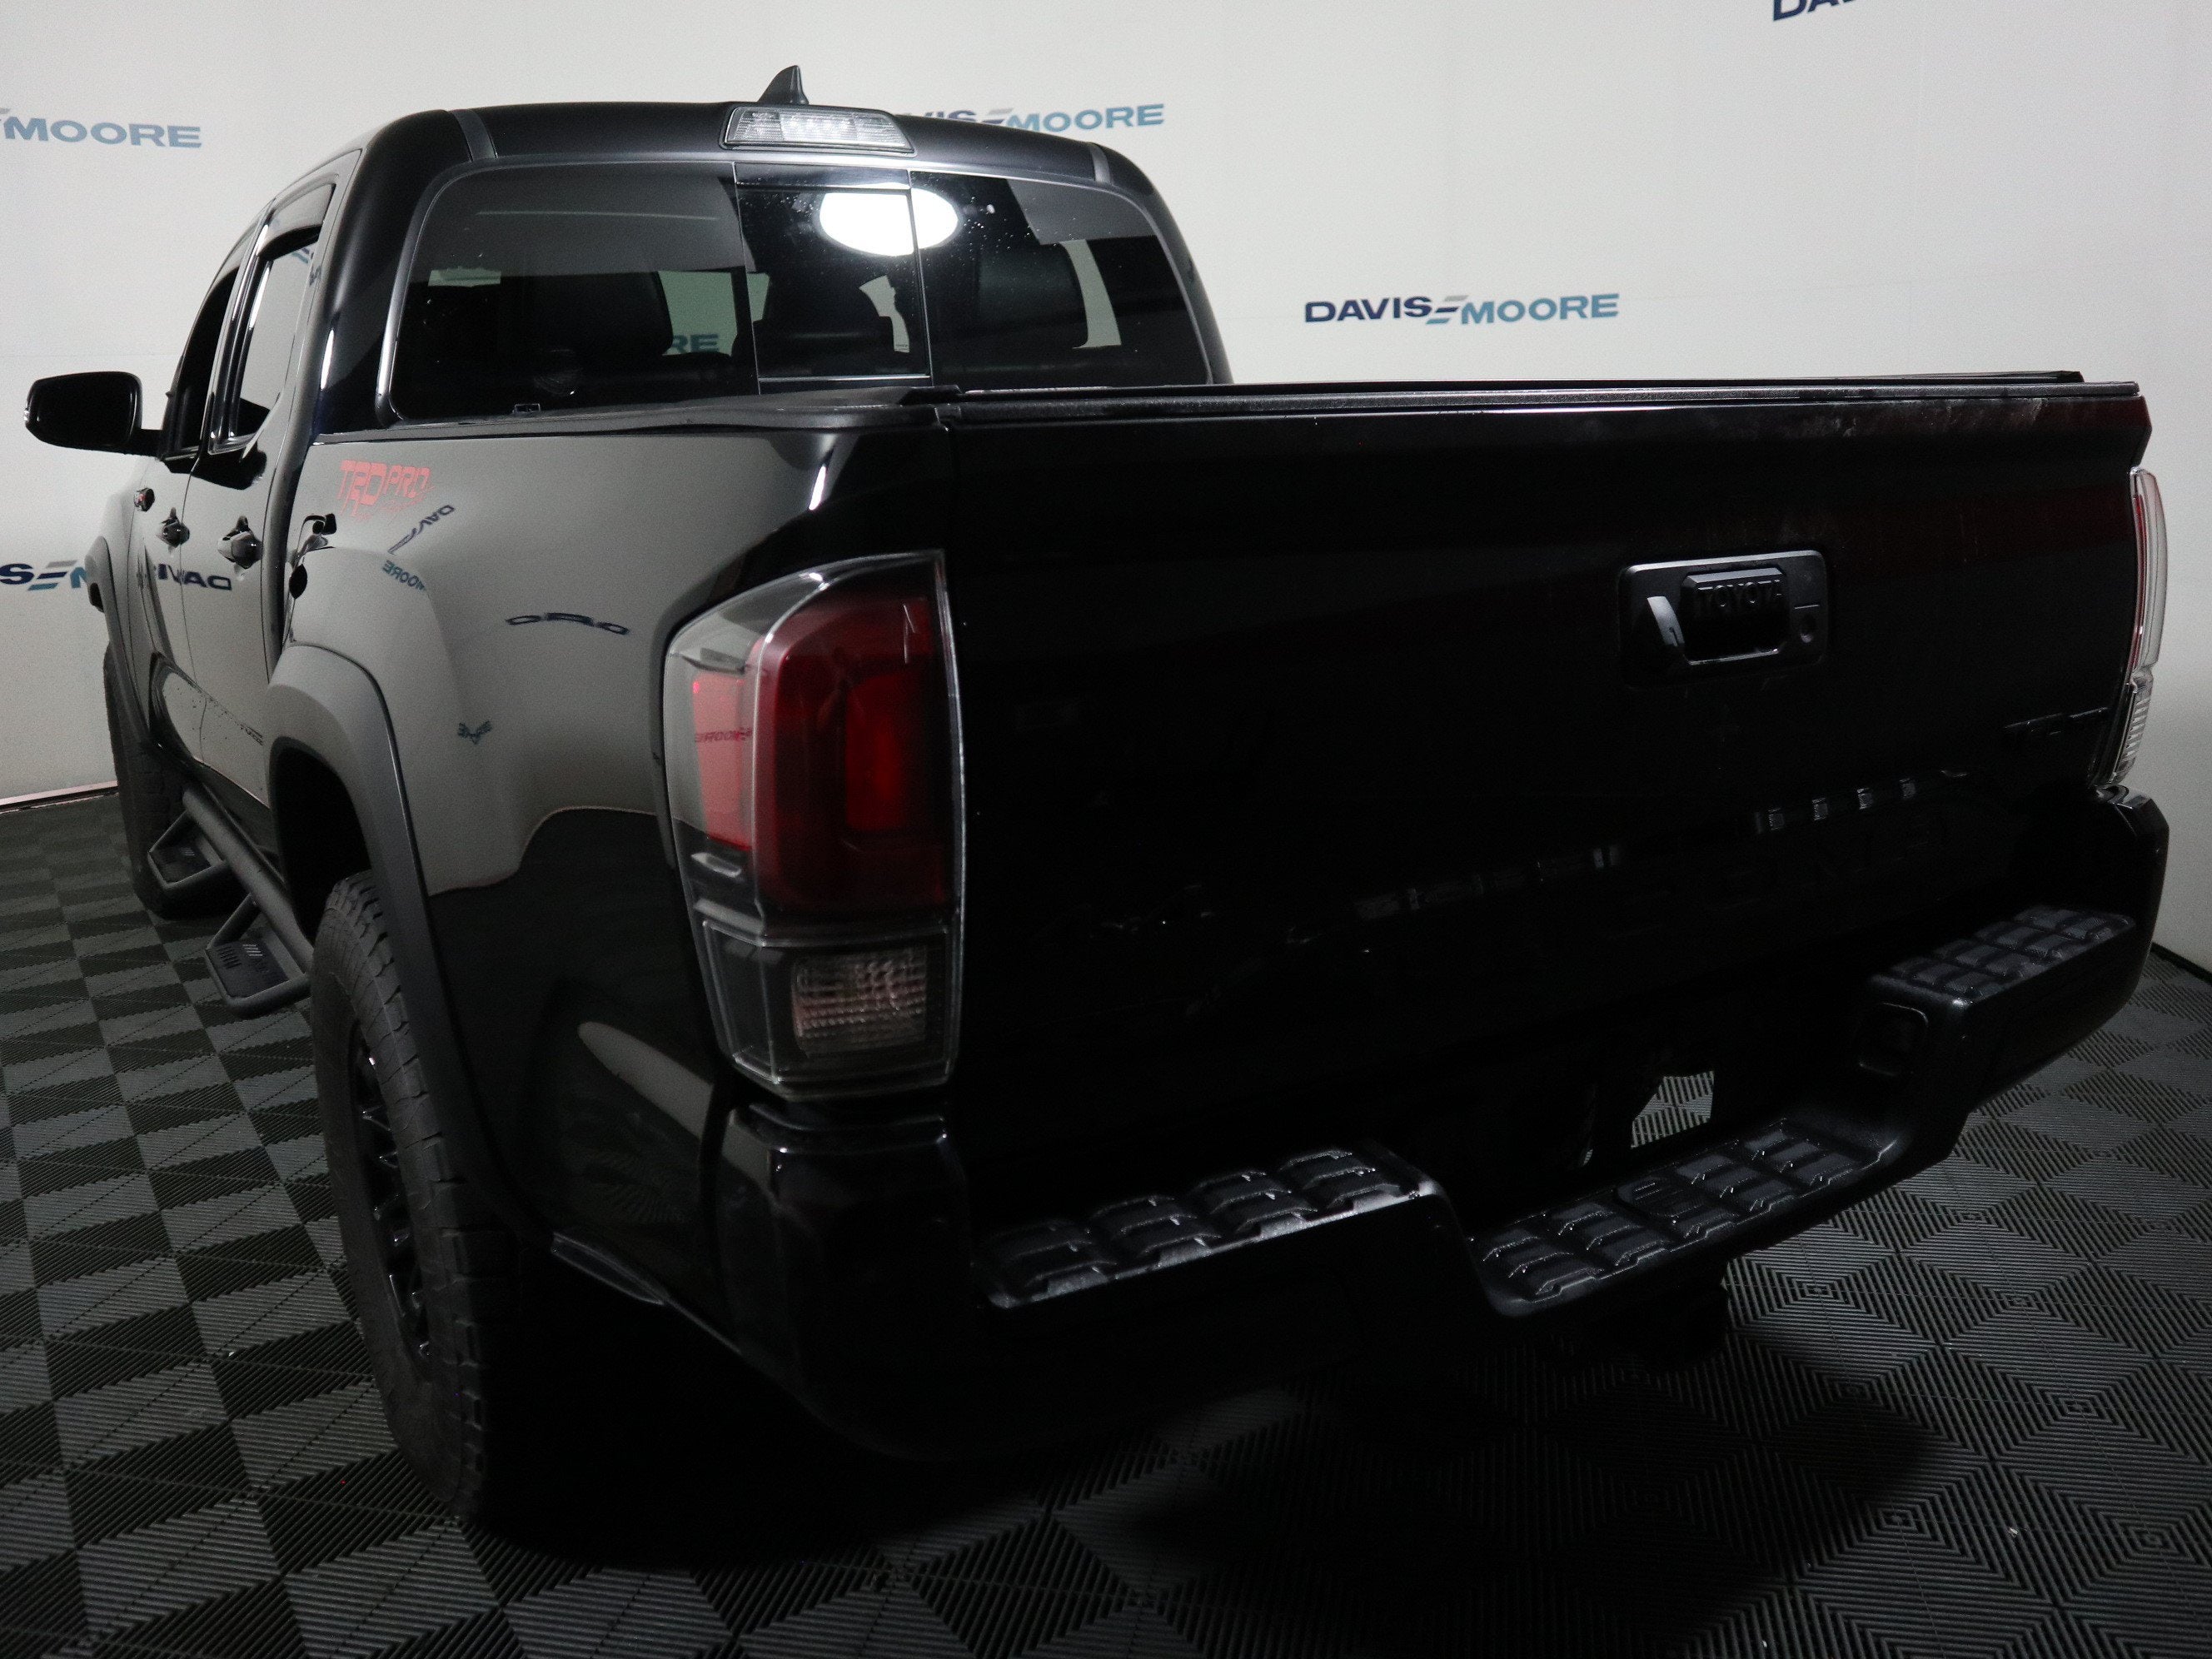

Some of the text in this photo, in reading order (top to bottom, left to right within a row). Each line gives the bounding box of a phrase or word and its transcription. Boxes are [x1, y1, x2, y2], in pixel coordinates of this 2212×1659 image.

[3, 116, 202, 149] MOORE
[1006, 103, 1164, 133] MOORE
[1304, 293, 1620, 325] DAVIS MOORE
